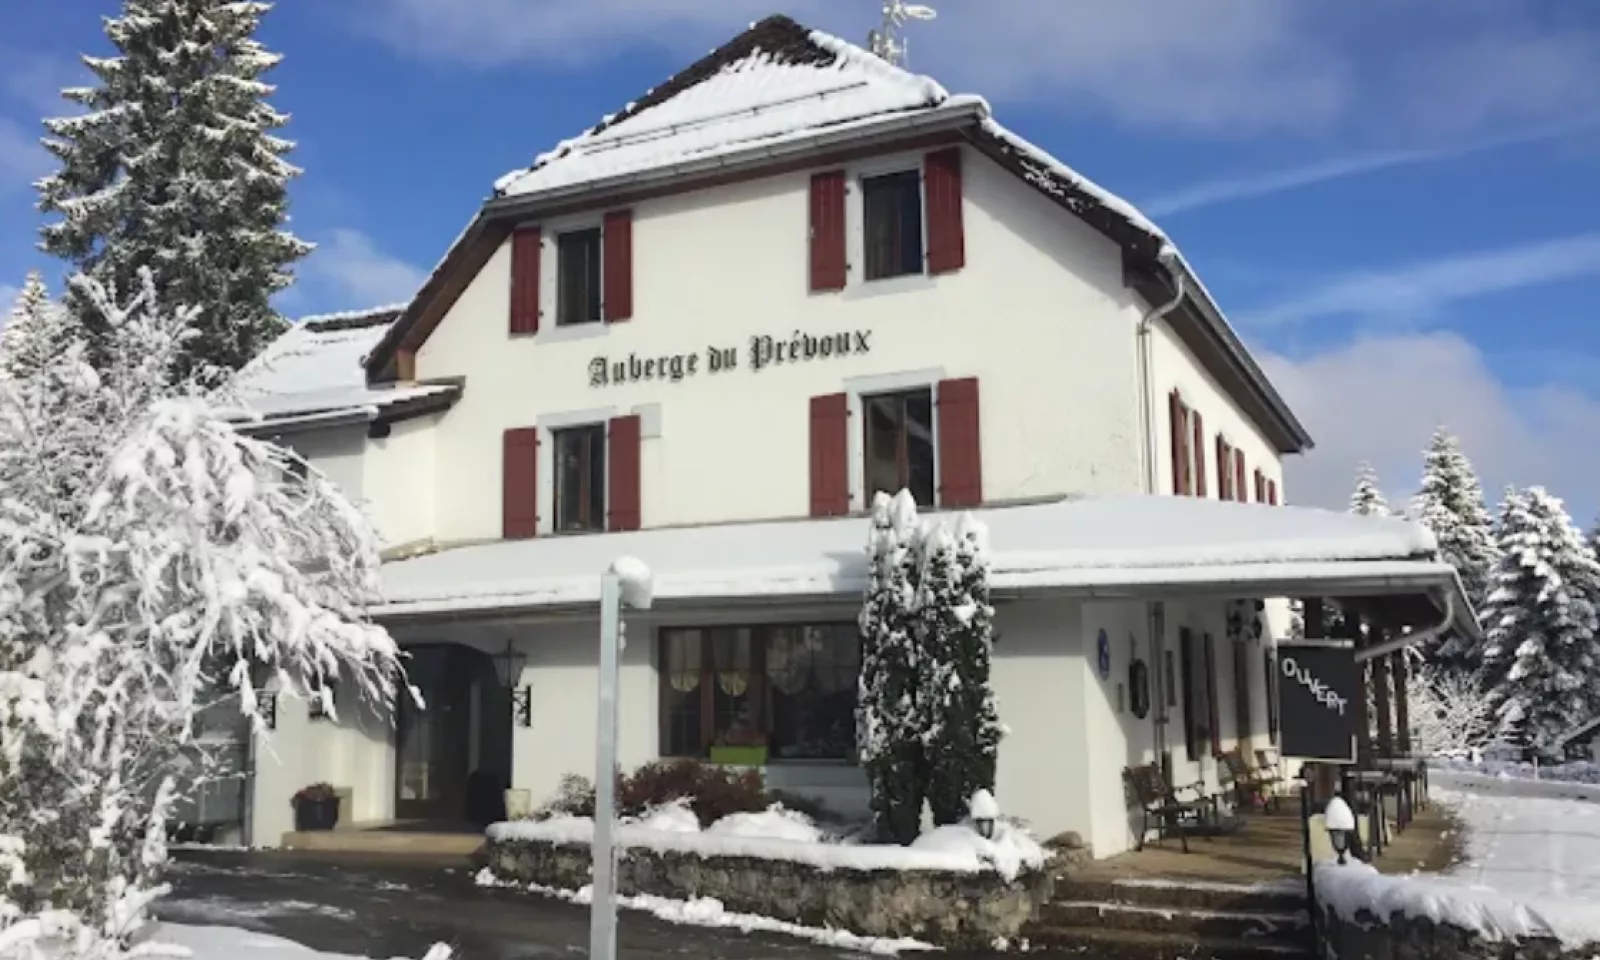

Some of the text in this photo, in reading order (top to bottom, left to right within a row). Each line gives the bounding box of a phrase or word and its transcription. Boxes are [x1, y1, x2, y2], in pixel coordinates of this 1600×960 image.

[588, 329, 872, 387] Auberge du Prévoux
[1281, 657, 1348, 717] OUVERT
